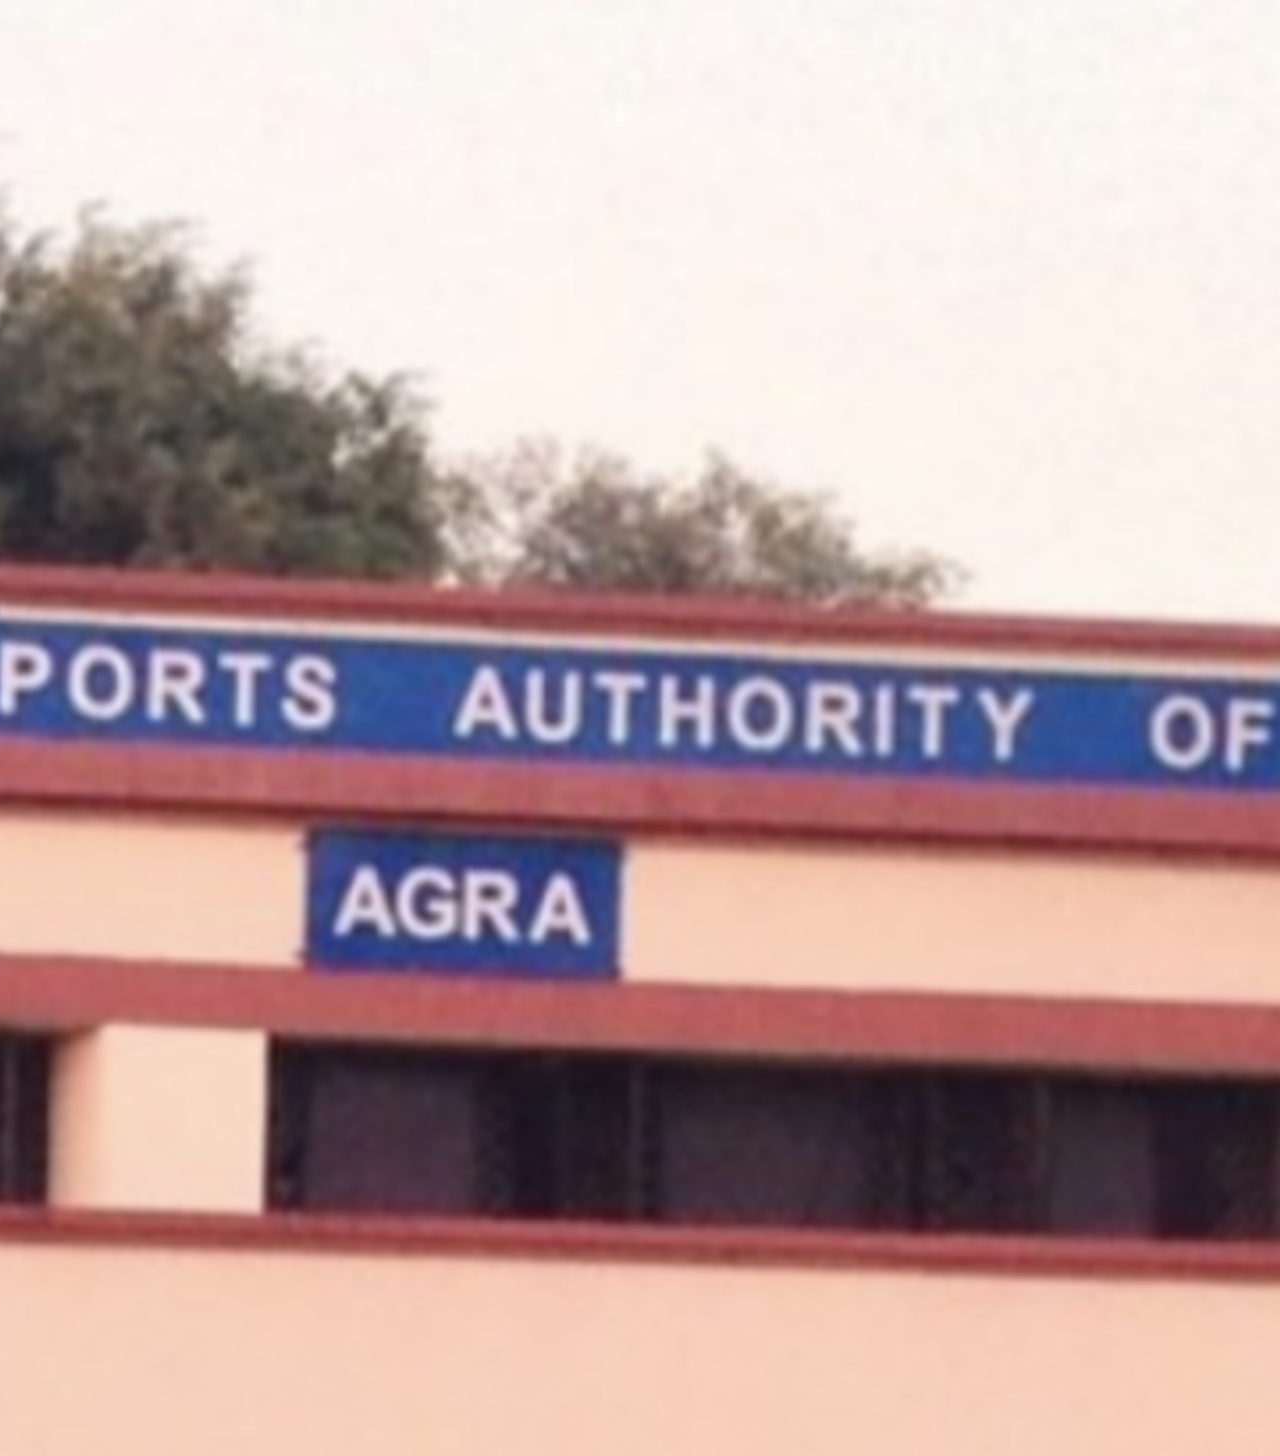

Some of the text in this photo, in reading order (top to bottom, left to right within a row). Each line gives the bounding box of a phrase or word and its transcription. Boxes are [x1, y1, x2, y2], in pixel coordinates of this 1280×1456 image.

[455, 665, 1032, 759] AUTHORITY
[1150, 694, 1274, 771] OF
[334, 866, 590, 944] AGRA
